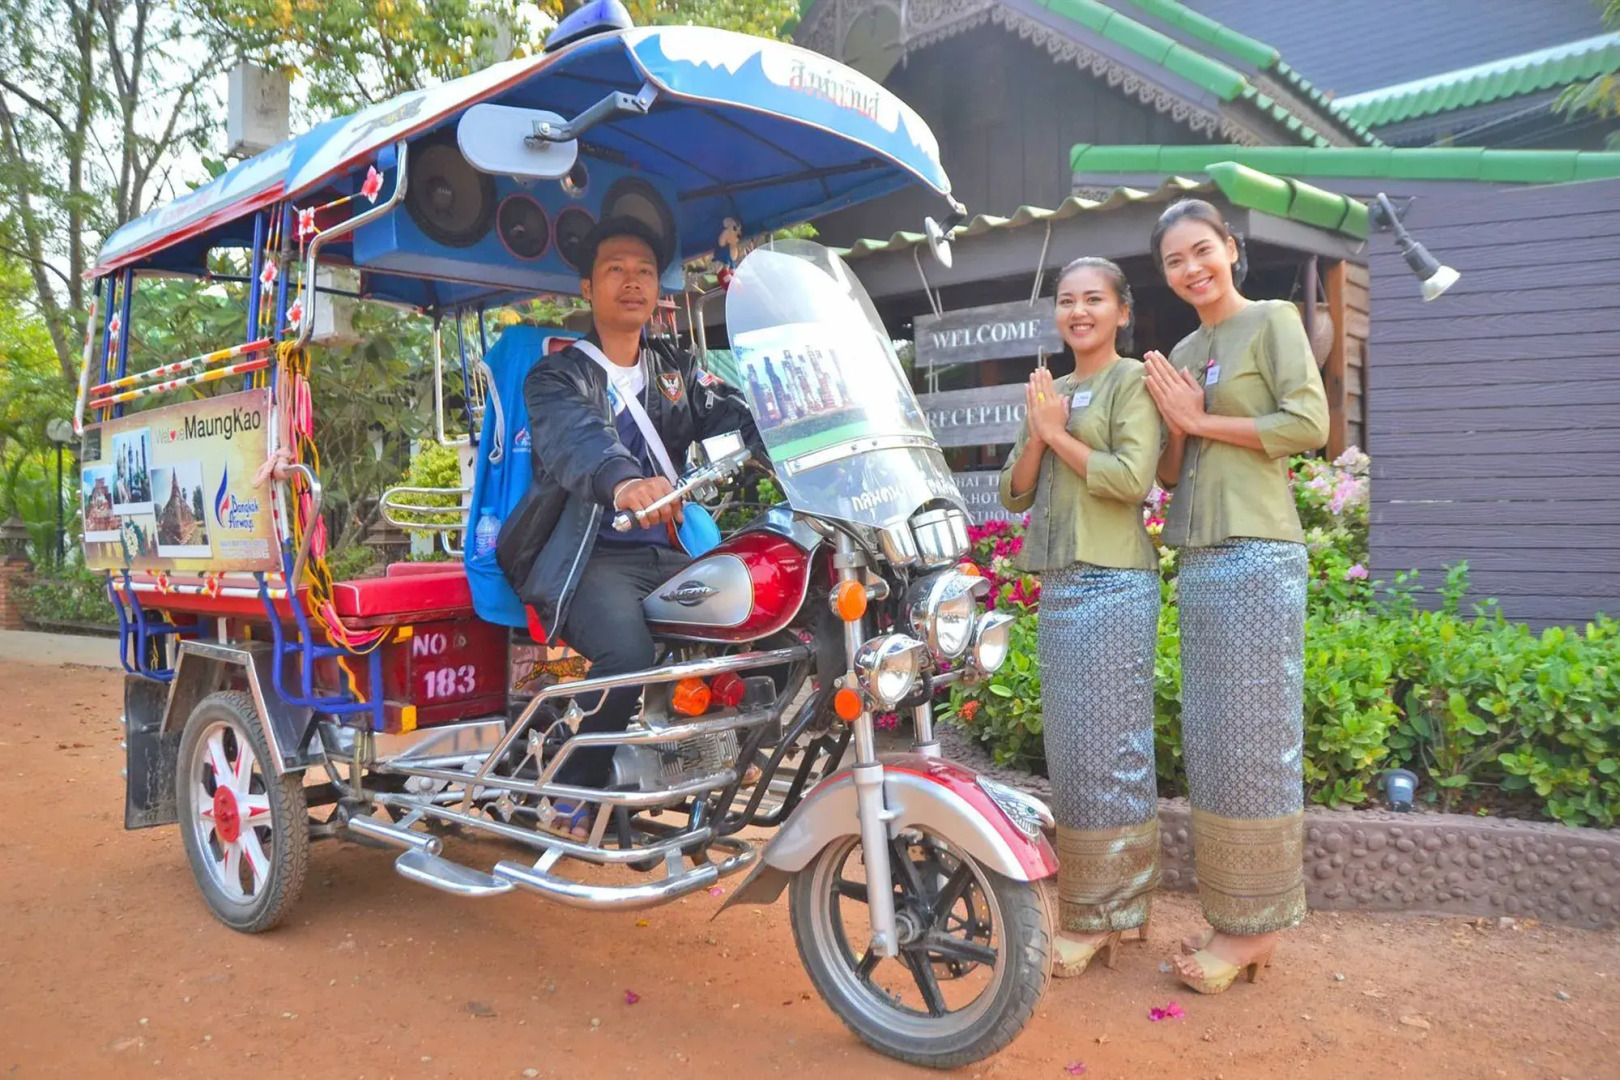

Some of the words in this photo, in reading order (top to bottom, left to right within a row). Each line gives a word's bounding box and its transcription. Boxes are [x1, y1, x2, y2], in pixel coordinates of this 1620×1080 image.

[932, 319, 1041, 349] WELCOME
[925, 404, 1028, 428] RECEPTIO
[413, 633, 447, 657] NO
[424, 665, 476, 699] 183
